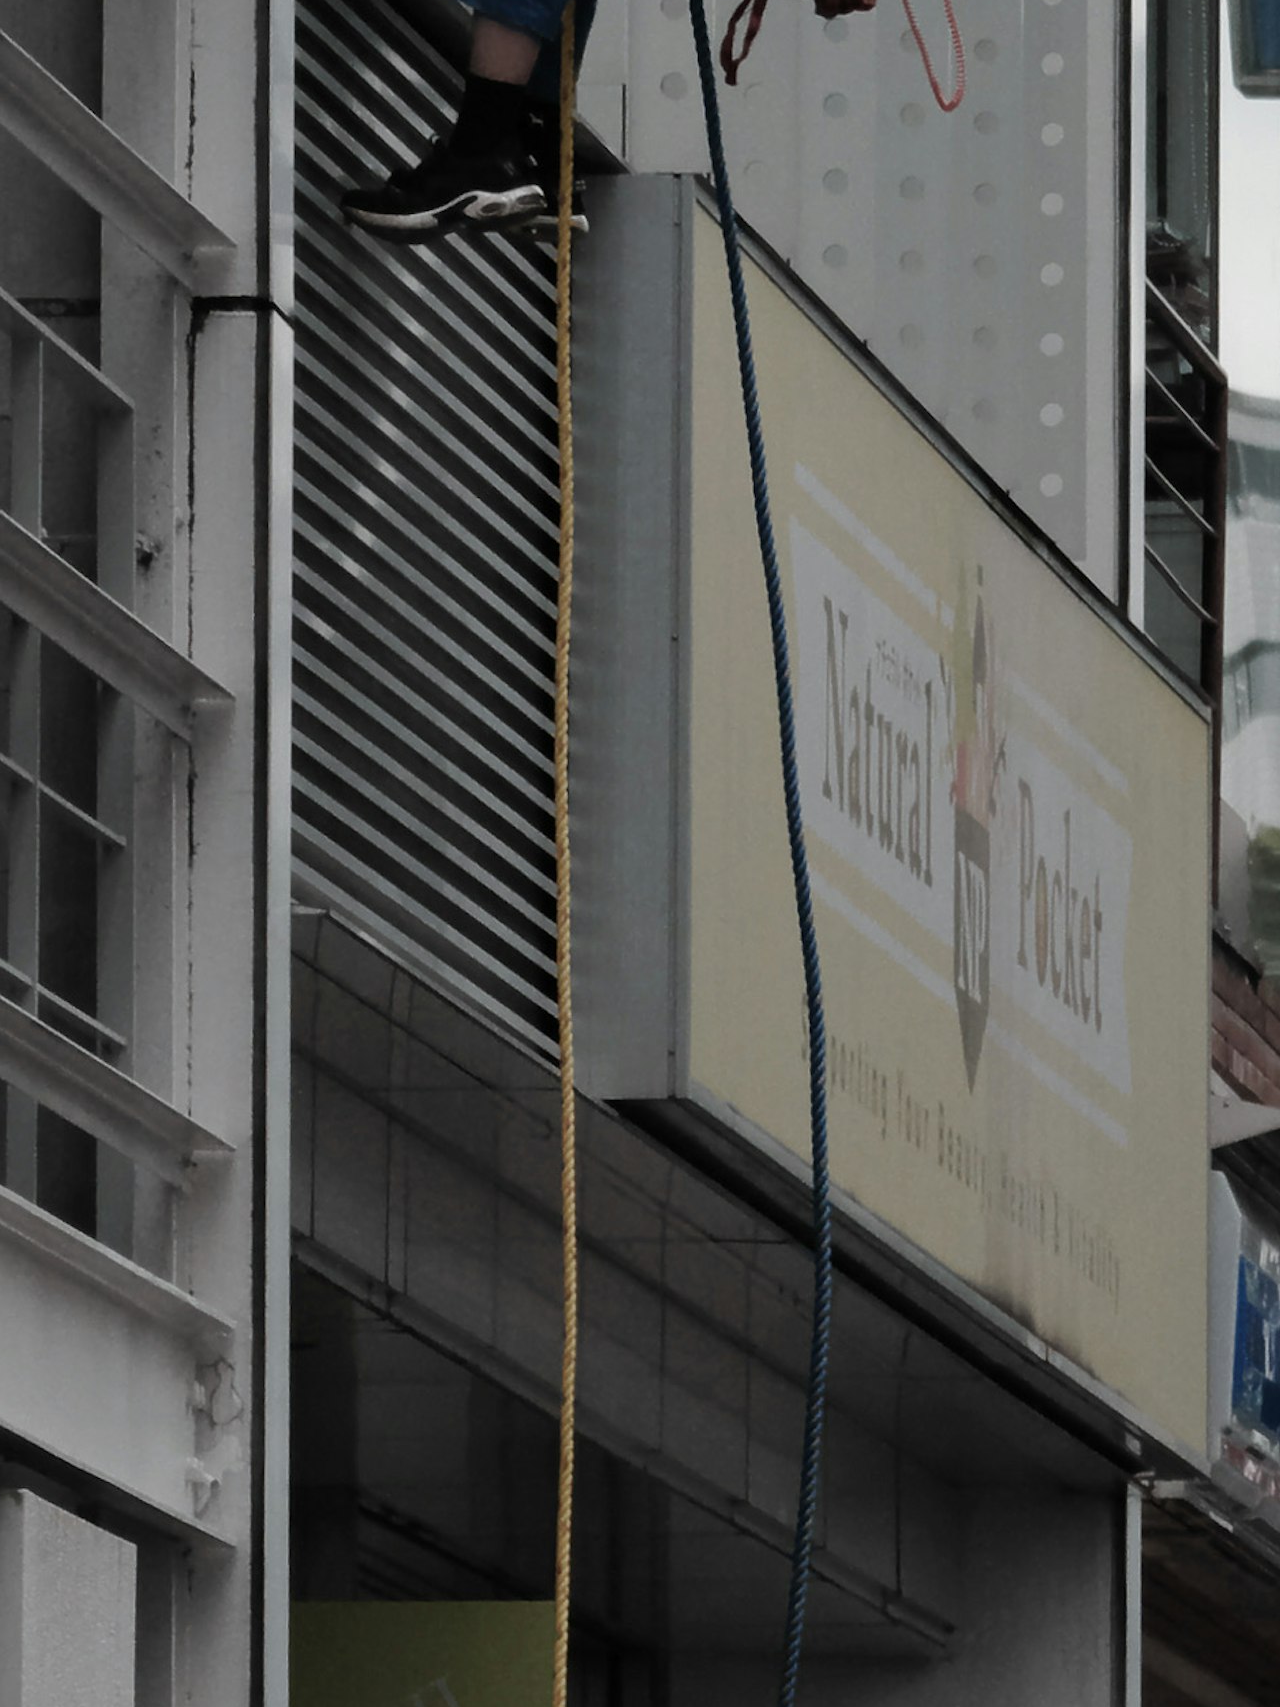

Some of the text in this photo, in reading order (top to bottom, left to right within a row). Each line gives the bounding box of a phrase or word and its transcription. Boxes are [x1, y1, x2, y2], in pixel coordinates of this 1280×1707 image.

[822, 595, 933, 889] Natural
[1016, 776, 1103, 1036] Pocket
[957, 850, 988, 1005] NP
